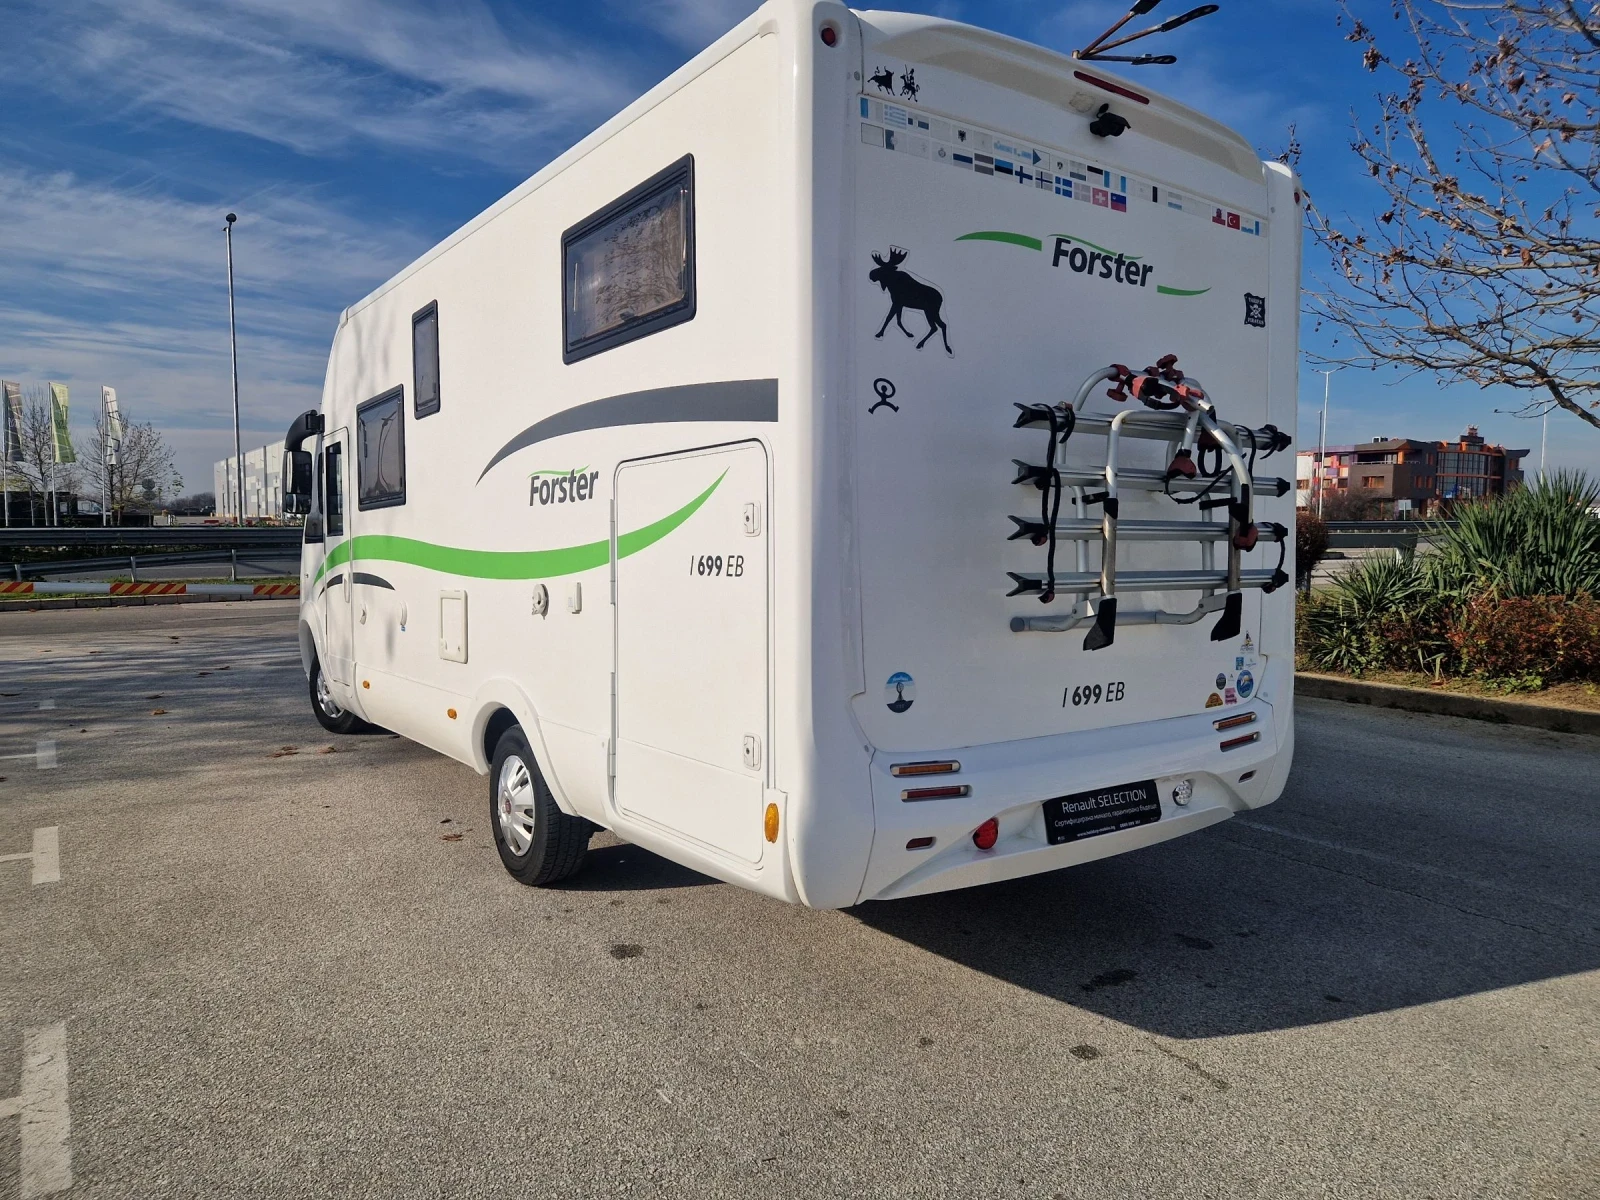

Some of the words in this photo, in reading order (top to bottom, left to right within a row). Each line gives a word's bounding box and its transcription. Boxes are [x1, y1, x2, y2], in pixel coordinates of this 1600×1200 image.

[1052, 237, 1153, 287] Forster
[529, 468, 599, 507] Forster
[697, 555, 723, 576] 699
[726, 555, 744, 577] EB
[1072, 684, 1102, 706] 699
[1105, 681, 1125, 702] EB
[1061, 797, 1097, 814] Renault
[1097, 789, 1147, 808] SELECTION
